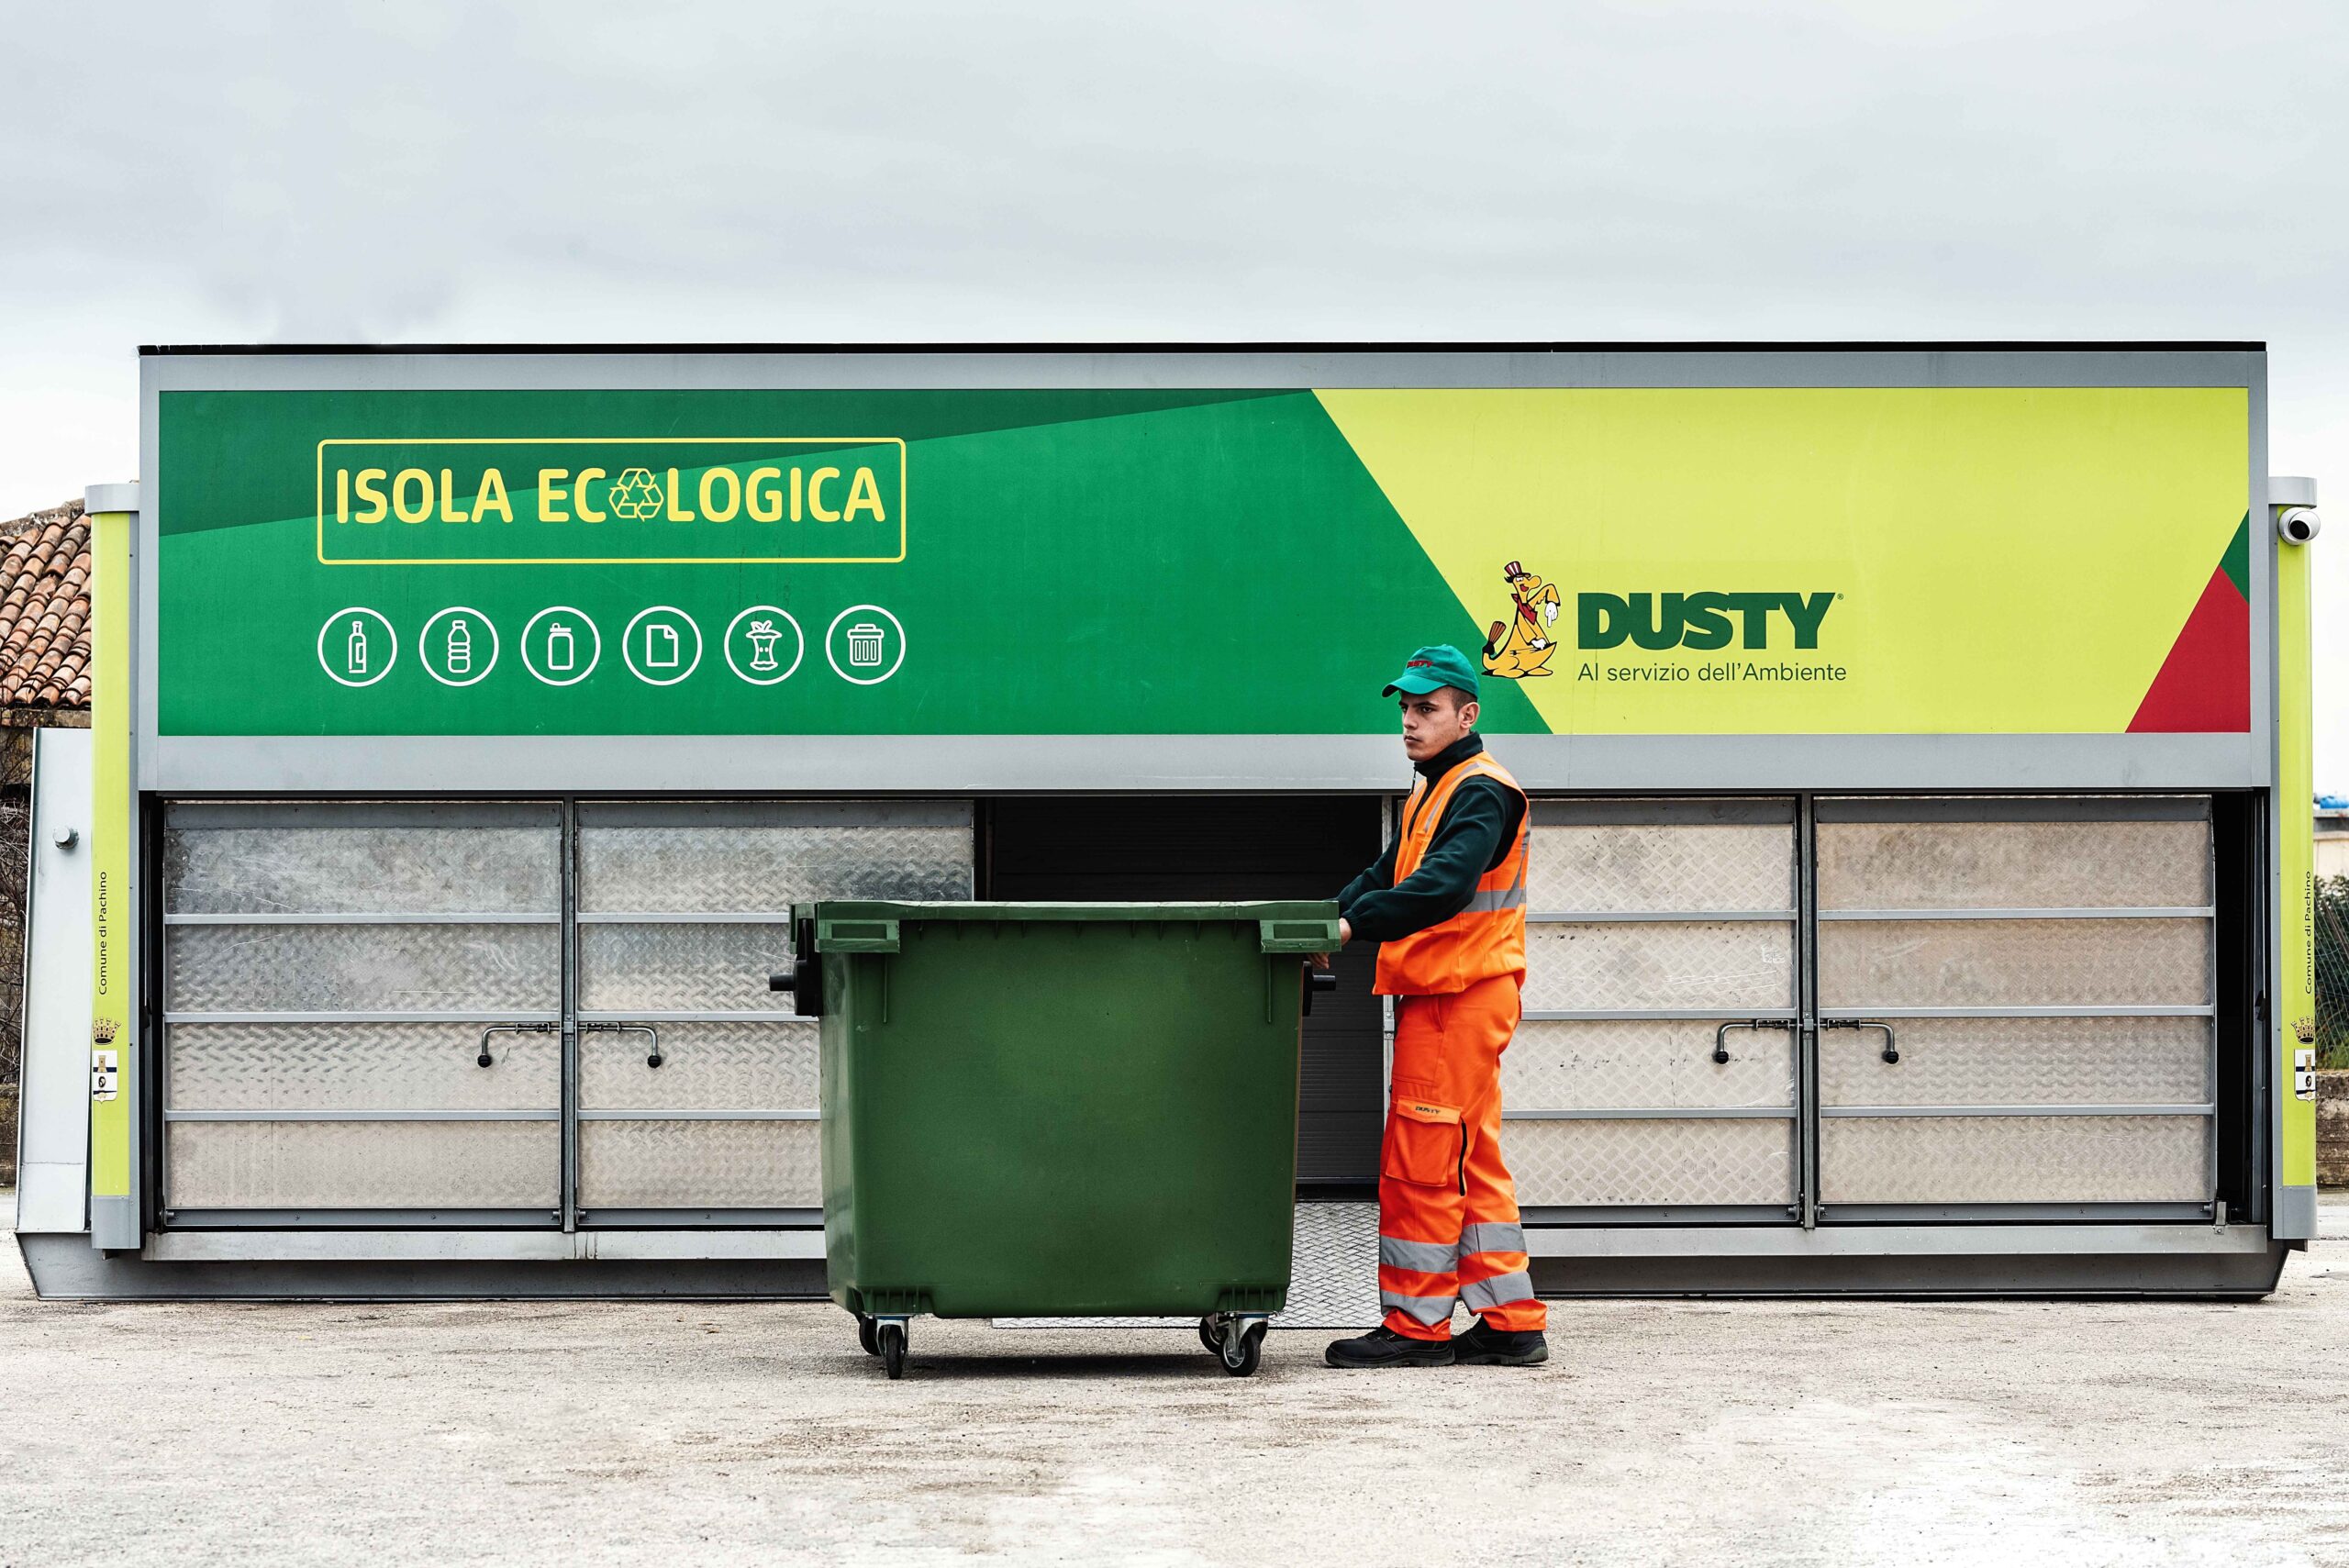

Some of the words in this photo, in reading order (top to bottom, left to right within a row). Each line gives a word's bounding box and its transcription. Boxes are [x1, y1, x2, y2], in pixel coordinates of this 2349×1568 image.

[337, 468, 514, 524] ISOLA
[1577, 662, 1598, 682] Al
[1607, 662, 1690, 682] servizio
[1698, 662, 1847, 682] dell’Ambiente
[98, 871, 107, 922] Pachino
[2304, 871, 2312, 921] Pachino
[98, 926, 107, 938] di
[2304, 925, 2312, 937] di
[98, 940, 107, 995] Comune
[2304, 940, 2312, 995] Comune
